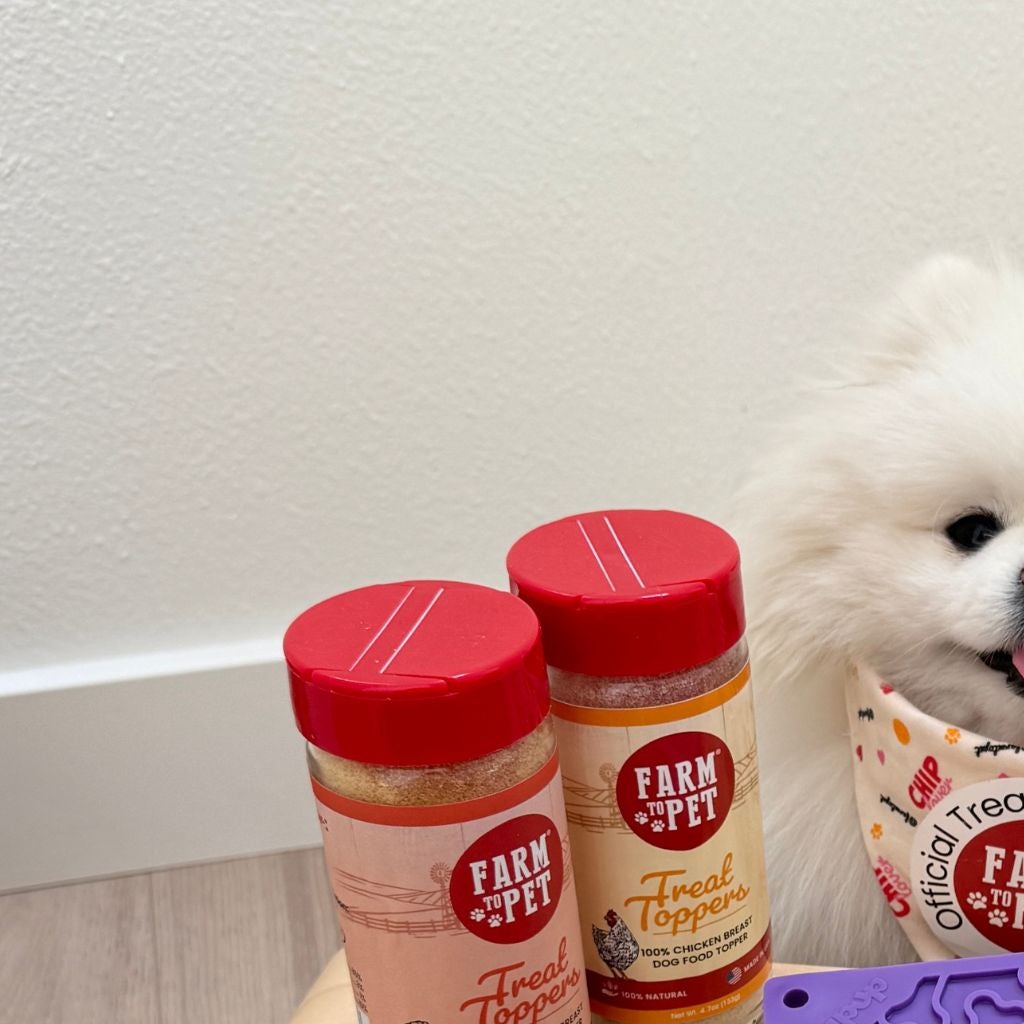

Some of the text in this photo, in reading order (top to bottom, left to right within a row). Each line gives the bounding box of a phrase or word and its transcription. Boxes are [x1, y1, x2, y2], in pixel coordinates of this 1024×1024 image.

[908, 755, 941, 809] CHIP
[647, 786, 718, 831] TO PET
[483, 871, 551, 923] TO PET
[640, 852, 735, 908] Treat
[920, 823, 962, 930] Official
[990, 888, 1012, 908] TO
[624, 884, 750, 936] Toppers
[641, 915, 753, 957] 100% CHICKEN BREAST
[478, 936, 569, 1006] Treat
[653, 932, 748, 969] DOG FOOD TOPPER
[645, 990, 688, 1000] NATURAL
